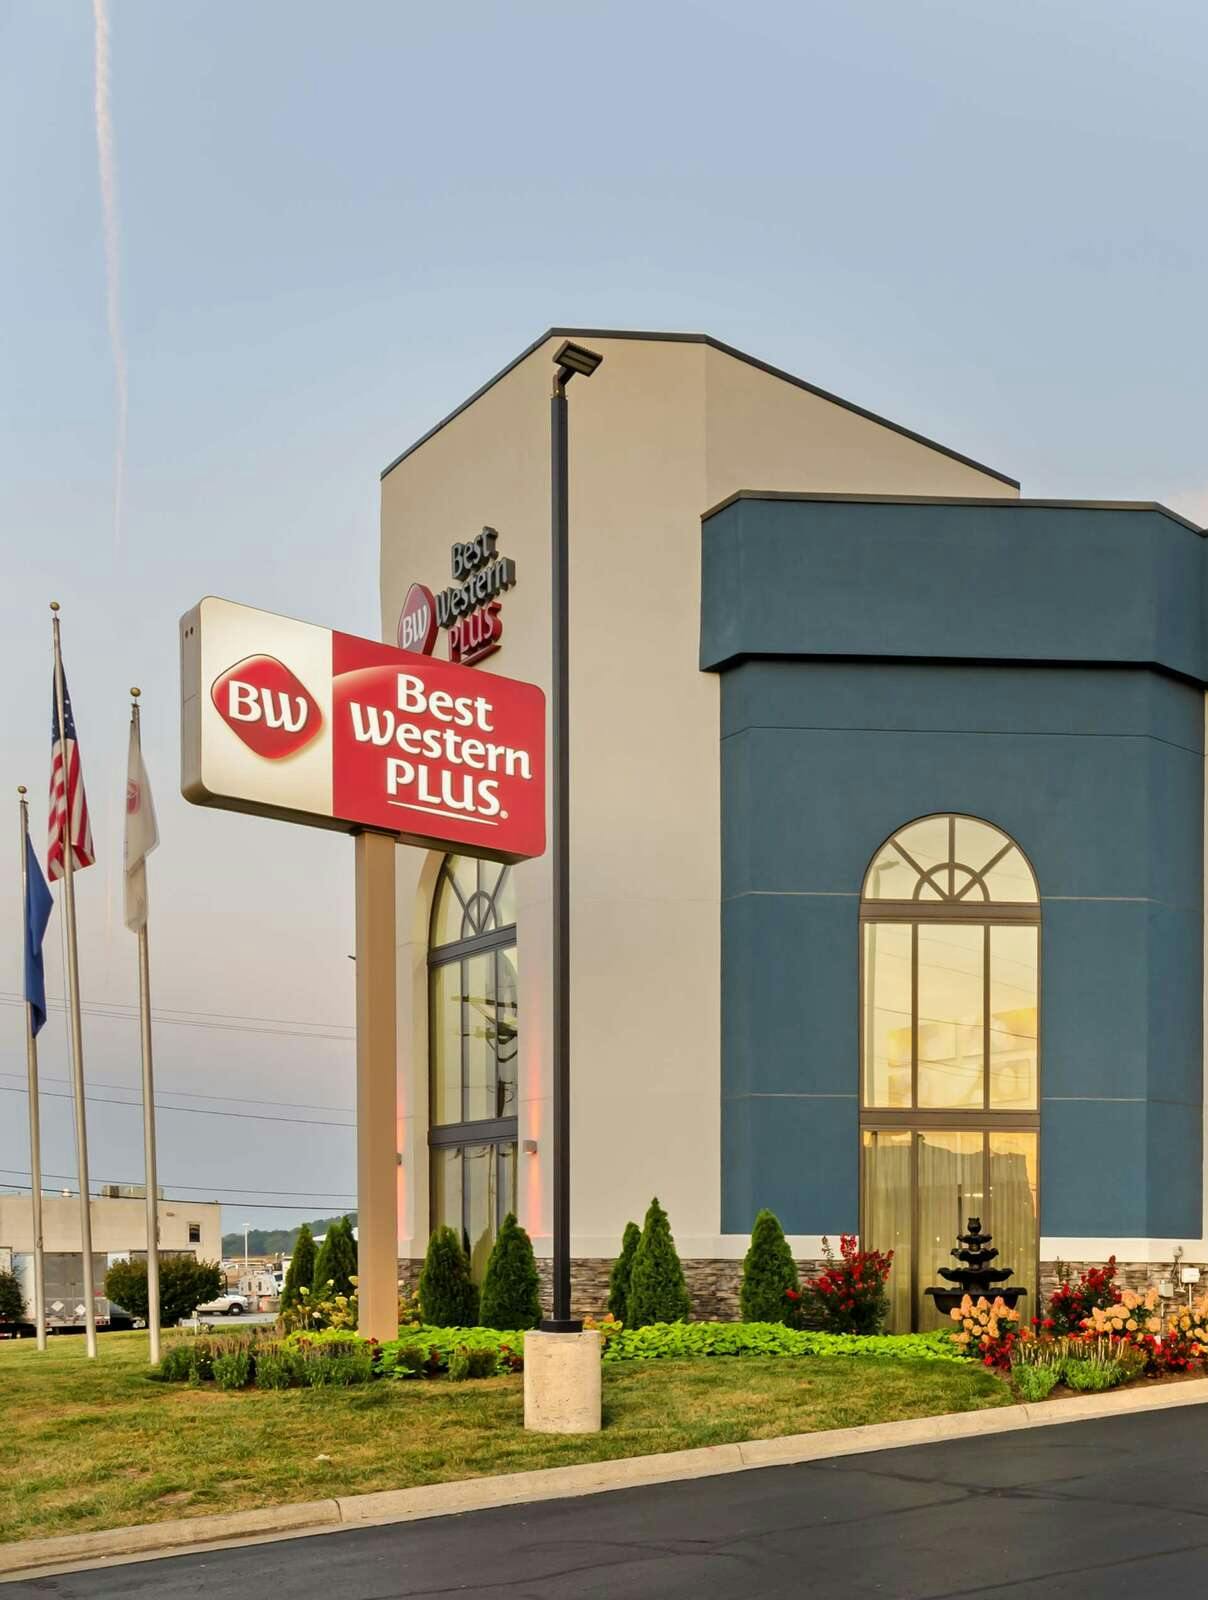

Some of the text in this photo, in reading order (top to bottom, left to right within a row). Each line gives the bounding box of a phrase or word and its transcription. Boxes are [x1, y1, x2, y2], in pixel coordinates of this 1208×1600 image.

[451, 526, 499, 582] Best
[435, 557, 516, 629] Western
[402, 605, 429, 650] BW
[448, 601, 503, 663] PLUS
[228, 680, 308, 733] BW
[397, 673, 494, 732] Best
[350, 702, 533, 780] Western
